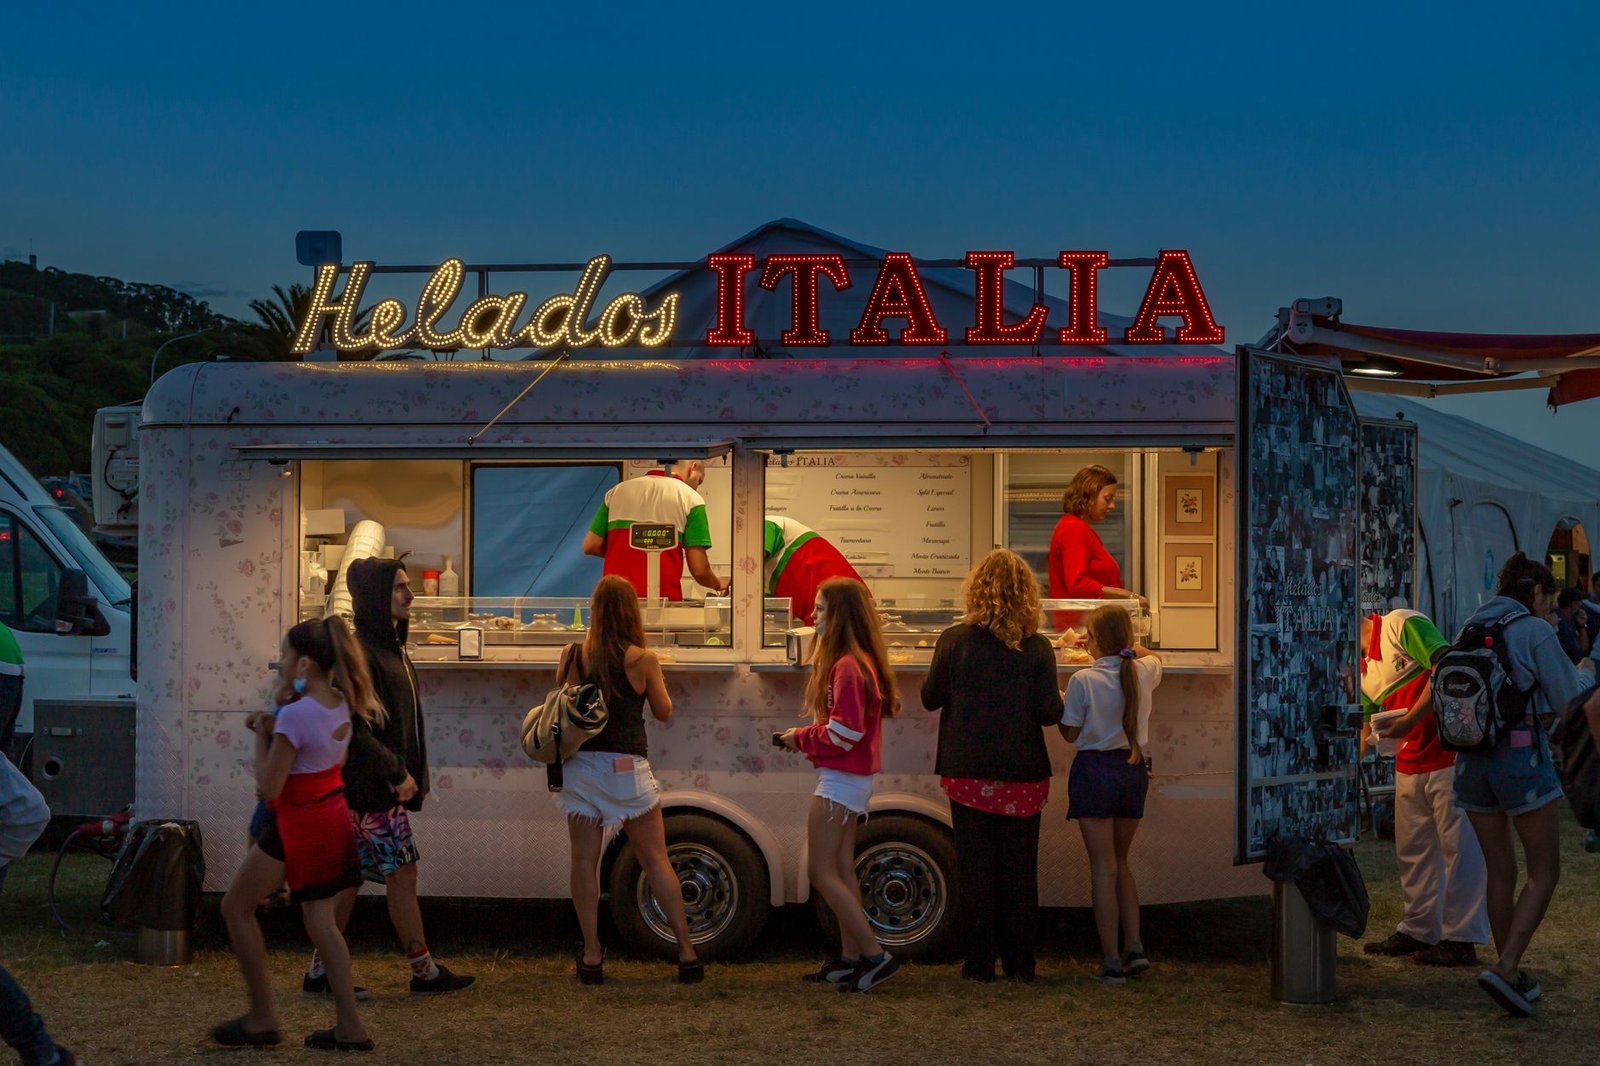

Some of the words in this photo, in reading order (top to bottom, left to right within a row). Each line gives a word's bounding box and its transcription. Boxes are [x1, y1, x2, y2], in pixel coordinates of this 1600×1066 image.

[290, 253, 680, 353] Helados
[706, 249, 1225, 347] ITALIA
[796, 457, 836, 466] ITALIA
[1275, 606, 1333, 632] ITALIA
